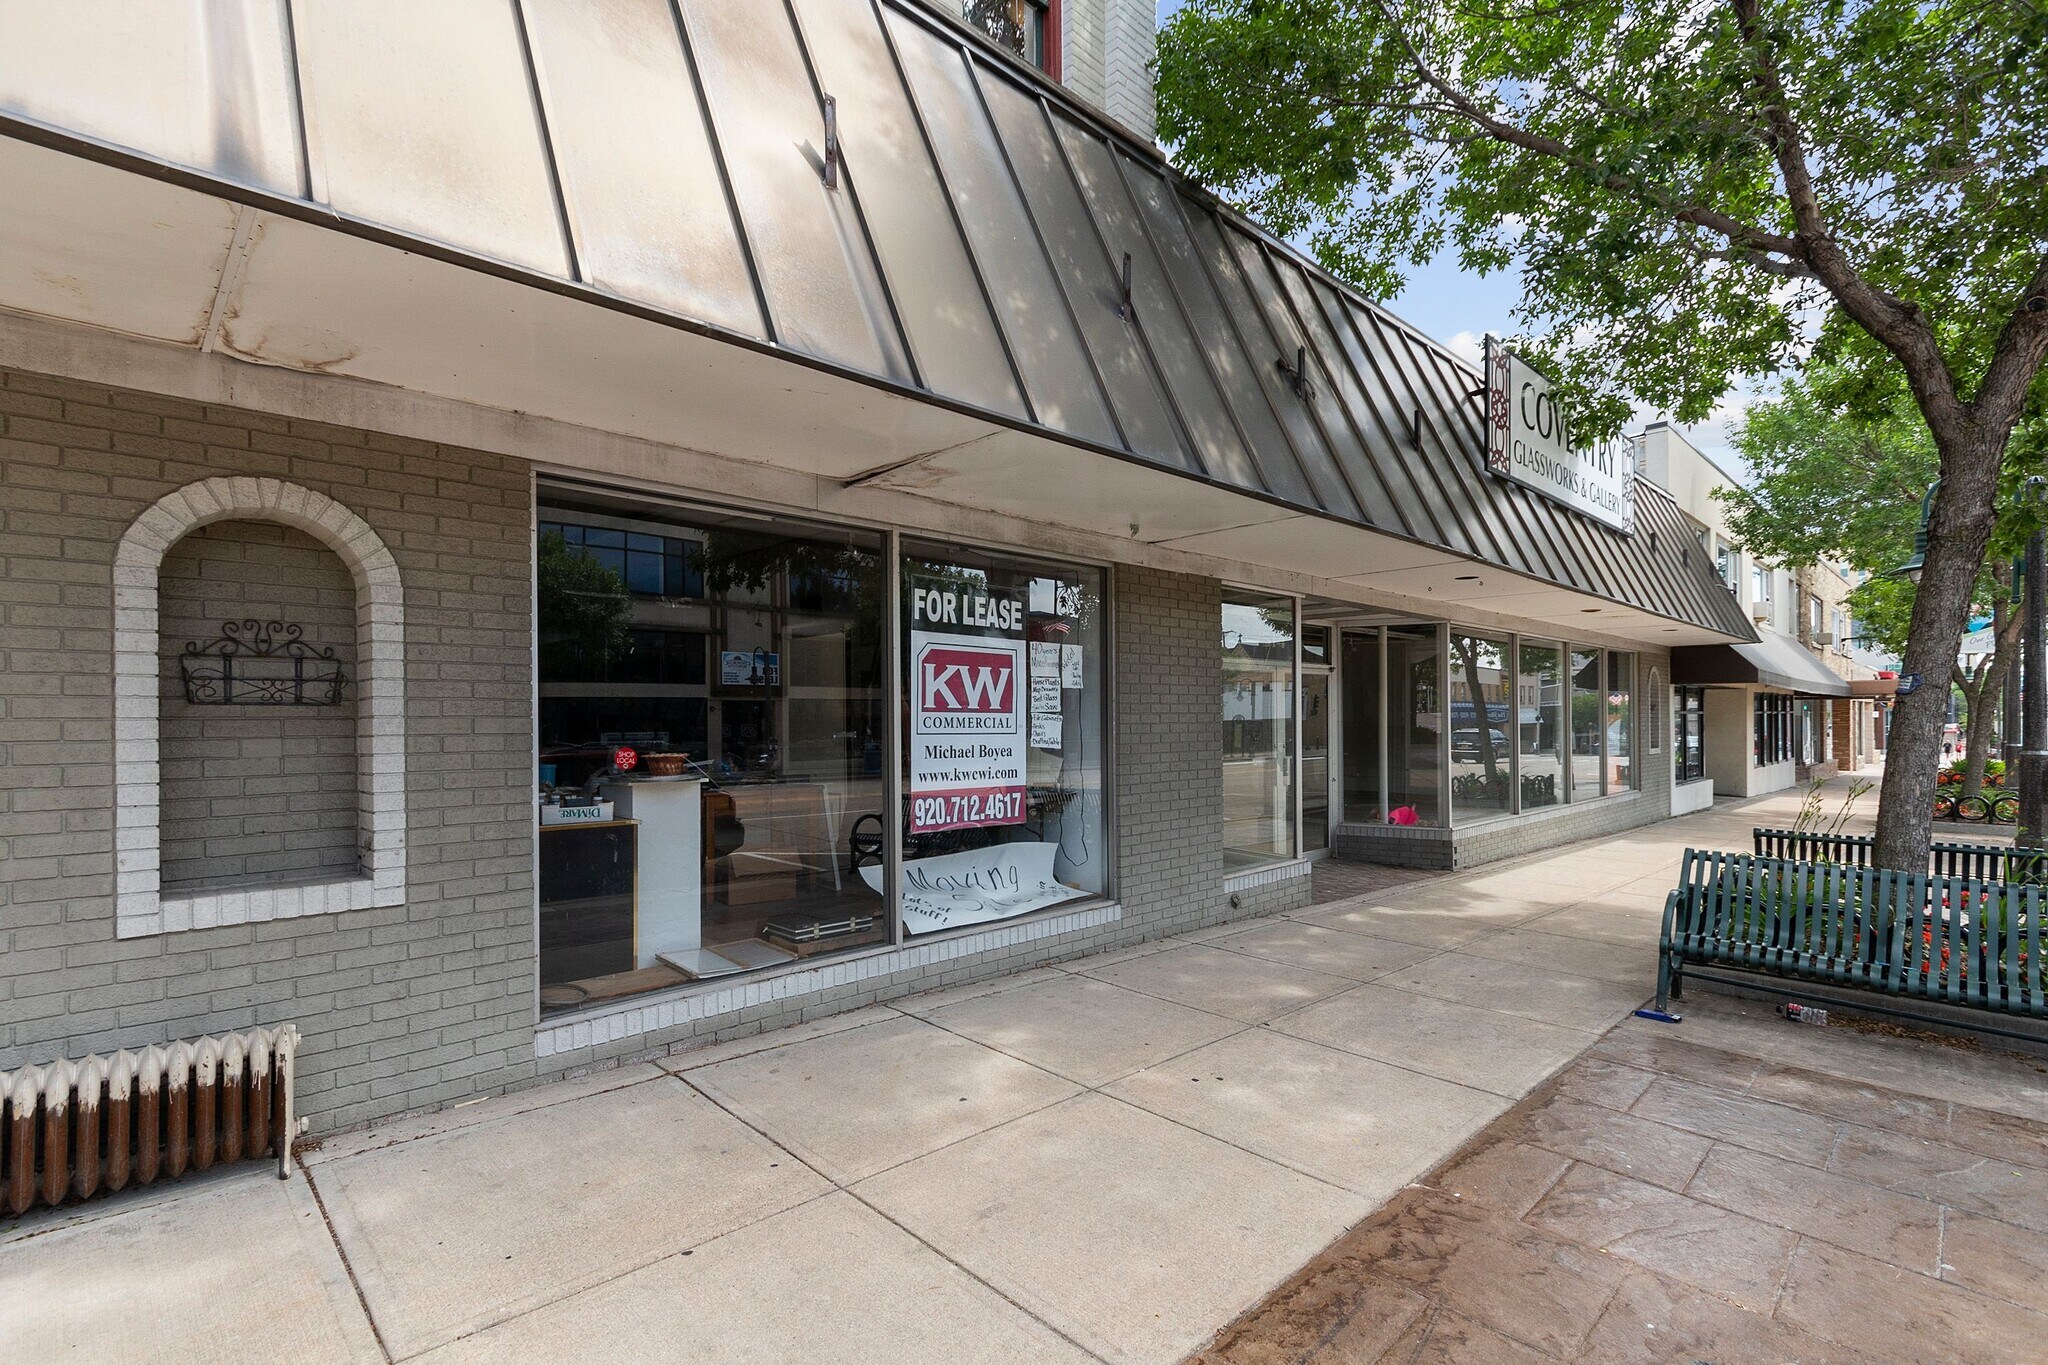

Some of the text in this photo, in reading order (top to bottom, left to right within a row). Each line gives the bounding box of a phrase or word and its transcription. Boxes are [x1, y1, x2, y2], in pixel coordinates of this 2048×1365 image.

[1513, 439, 1621, 515] GLASSWORKS & GALLERY
[914, 588, 1023, 631] FOR LEASE
[923, 663, 1012, 709] KW
[1043, 694, 1058, 702] Glass
[923, 716, 1012, 730] COMMERCIAL
[924, 744, 1013, 761] Michael Boyea
[918, 766, 1019, 783] www.kwcwi.com
[914, 792, 1021, 827] 920.712.4617
[906, 865, 1019, 893] Moving
